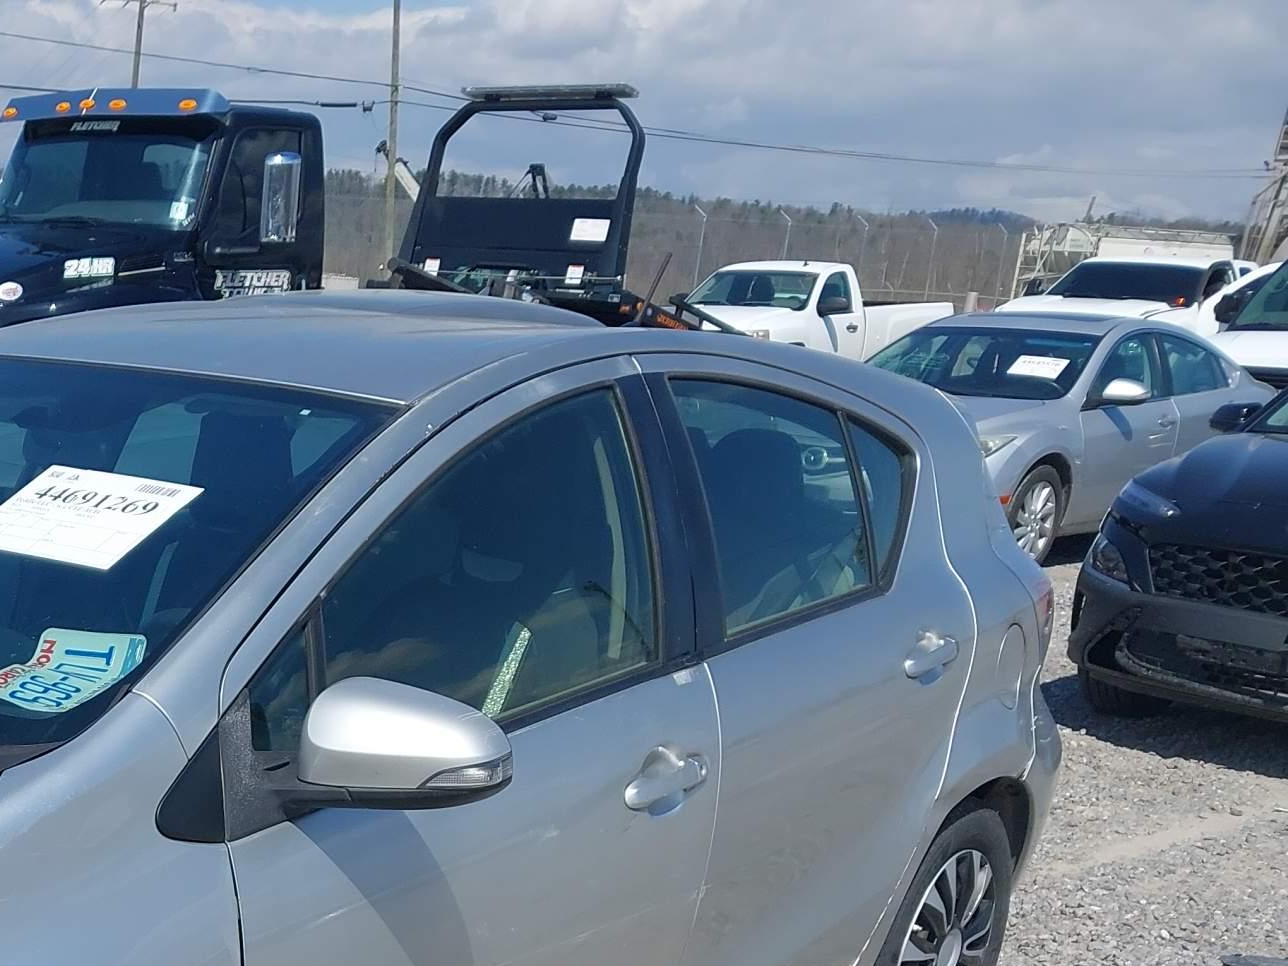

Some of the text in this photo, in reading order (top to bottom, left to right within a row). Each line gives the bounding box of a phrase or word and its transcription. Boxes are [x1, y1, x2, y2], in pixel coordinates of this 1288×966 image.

[64, 257, 115, 278] 24 HR
[215, 270, 291, 290] FLETCHER
[35, 485, 159, 516] 44691269
